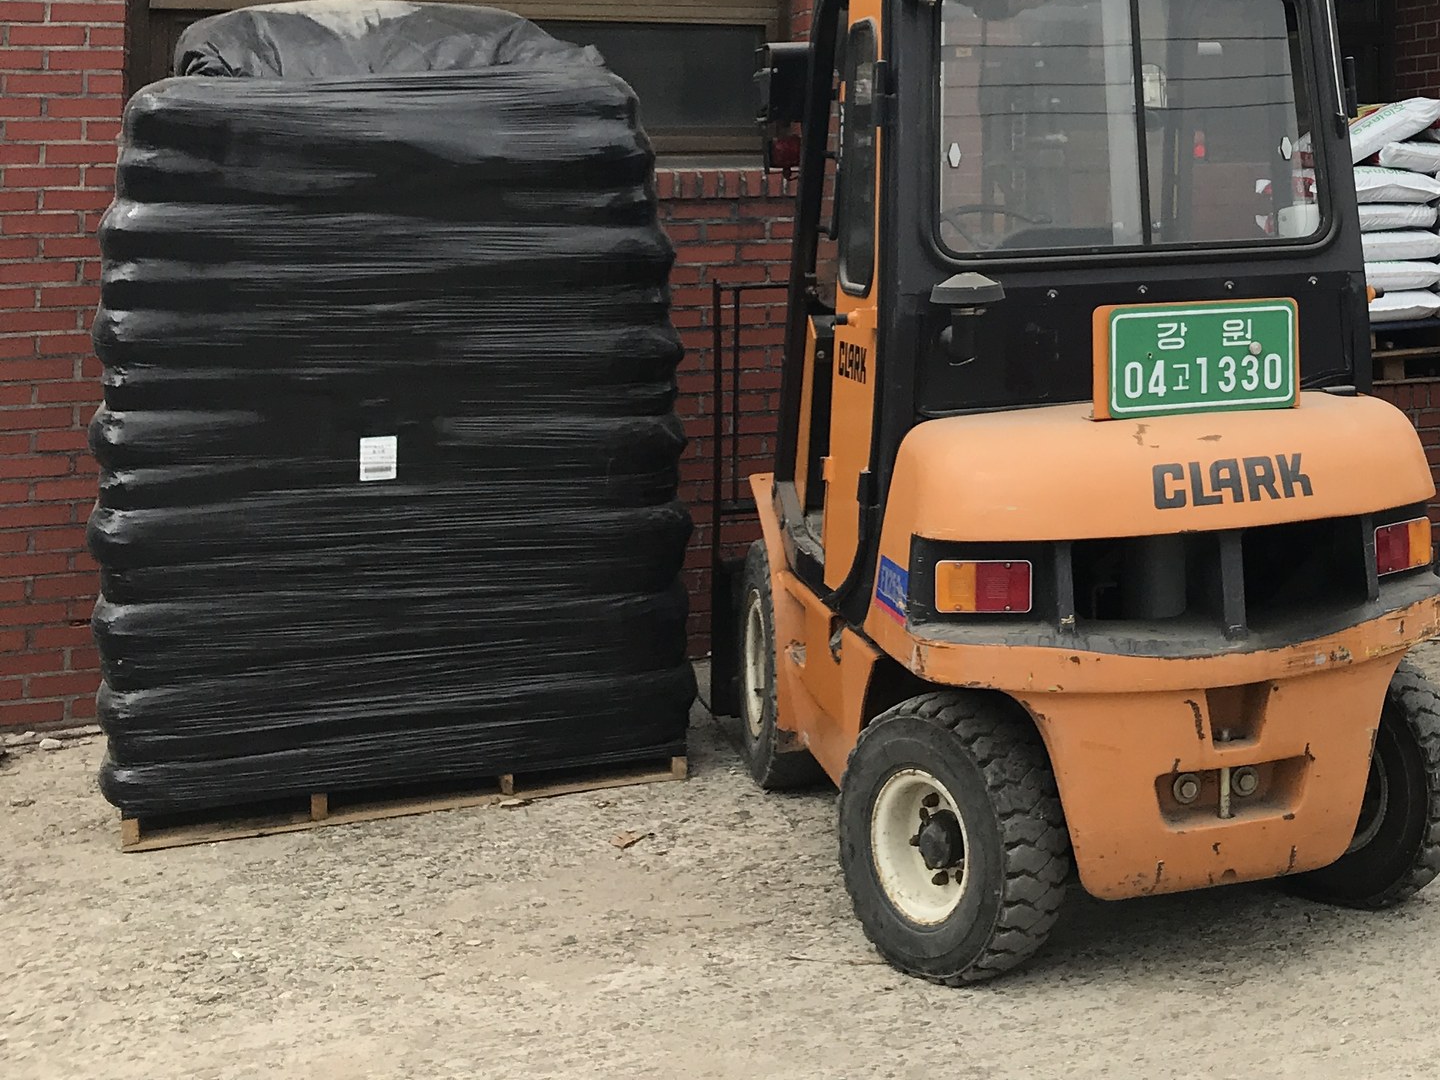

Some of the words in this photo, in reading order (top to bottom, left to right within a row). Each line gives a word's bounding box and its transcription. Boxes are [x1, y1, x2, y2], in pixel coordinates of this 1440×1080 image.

[839, 341, 867, 384] CLARK
[1124, 353, 1282, 399] 04고1330
[1152, 453, 1314, 510] CLARK
